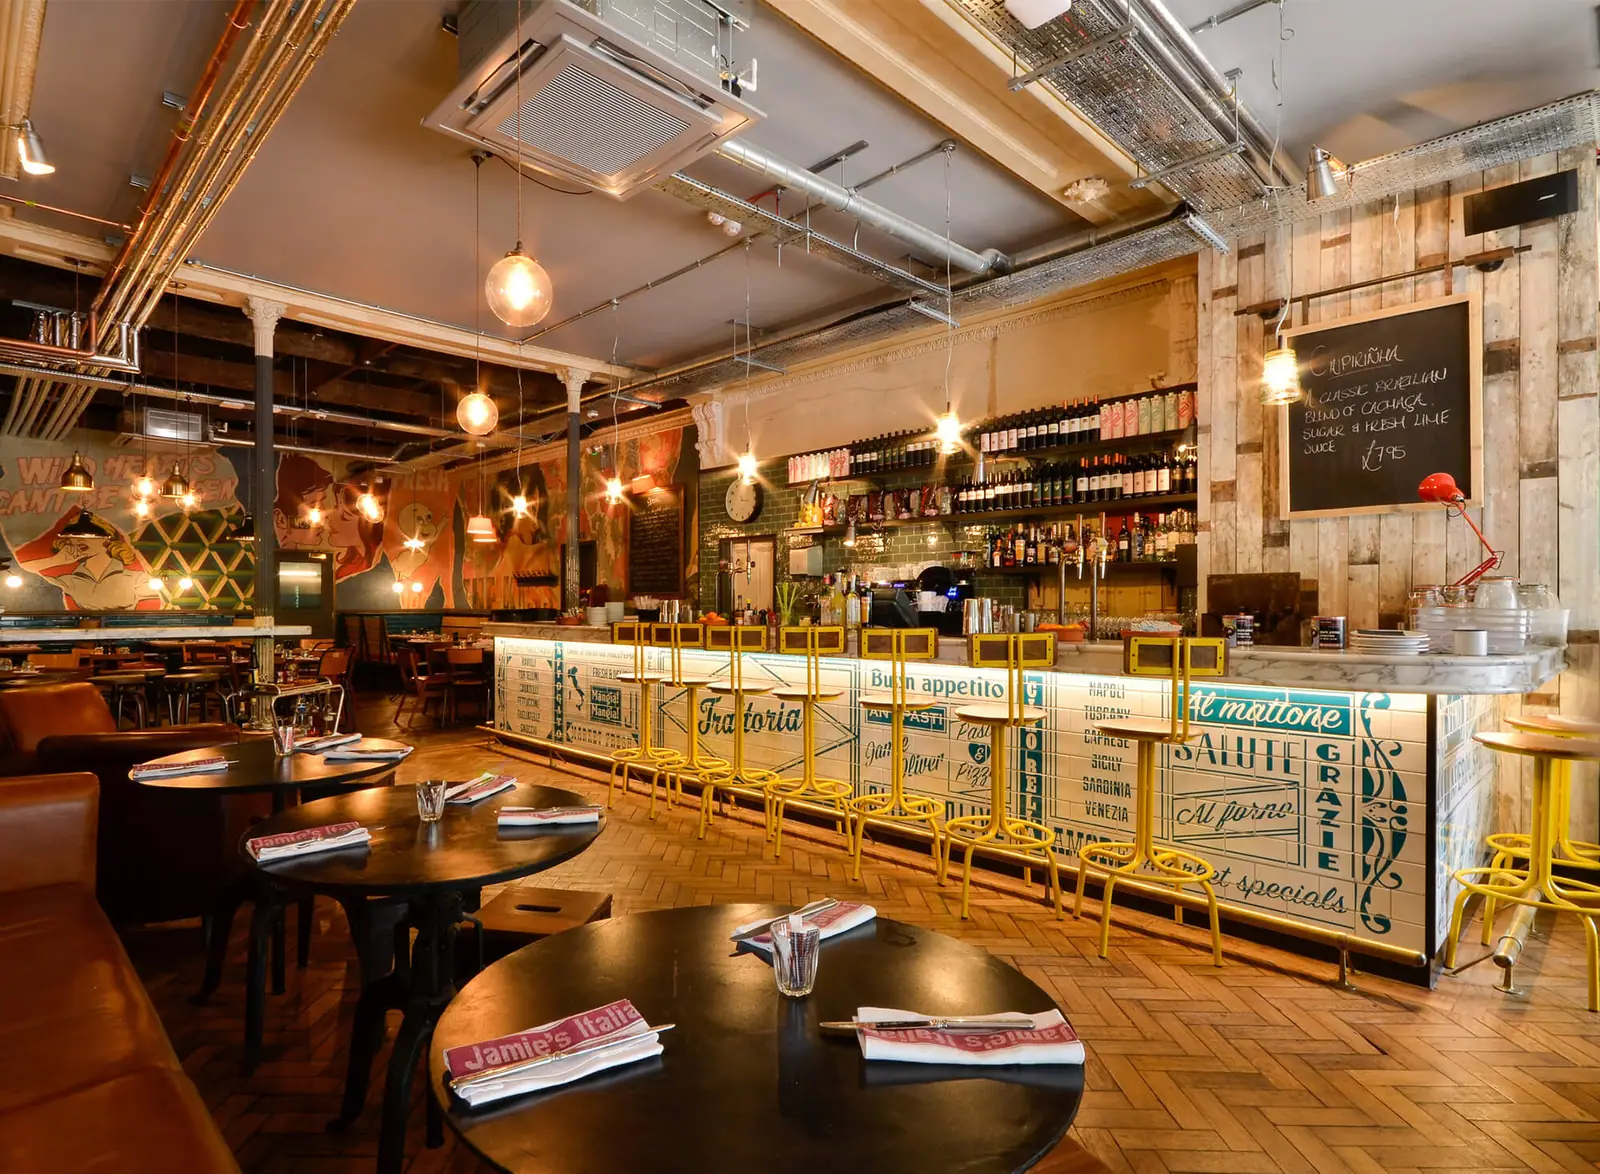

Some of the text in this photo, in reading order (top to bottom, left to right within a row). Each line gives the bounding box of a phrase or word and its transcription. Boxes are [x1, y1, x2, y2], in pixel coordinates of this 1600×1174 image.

[1305, 367, 1447, 408] A CLASSIC BRAZILIAN
[1303, 424, 1345, 440] SUGAR
[1365, 415, 1406, 432] FRESH
[1414, 409, 1452, 427] LIME
[1305, 409, 1340, 424] BLEND
[1343, 404, 1356, 417] OF
[1304, 440, 1337, 455] JUICE
[592, 689, 620, 703] Mangia!
[922, 676, 1004, 698] appetito
[1088, 681, 1126, 699] NAPOLI
[592, 705, 620, 720] Mangia!
[869, 709, 943, 725] ANPASTI
[1083, 705, 1131, 721] TUSCANY
[1187, 690, 1343, 728] Al mattone
[974, 748, 984, 760] &
[1091, 754, 1123, 773] SICILY
[956, 763, 992, 788] Pizz
[1083, 777, 1132, 798] SARDINIA
[1085, 801, 1129, 823] VENEZIA
[1176, 800, 1294, 831] Al forno
[1315, 743, 1342, 872] GRAZIE
[1236, 872, 1350, 914] specials
[465, 1029, 571, 1070] Jamie's
